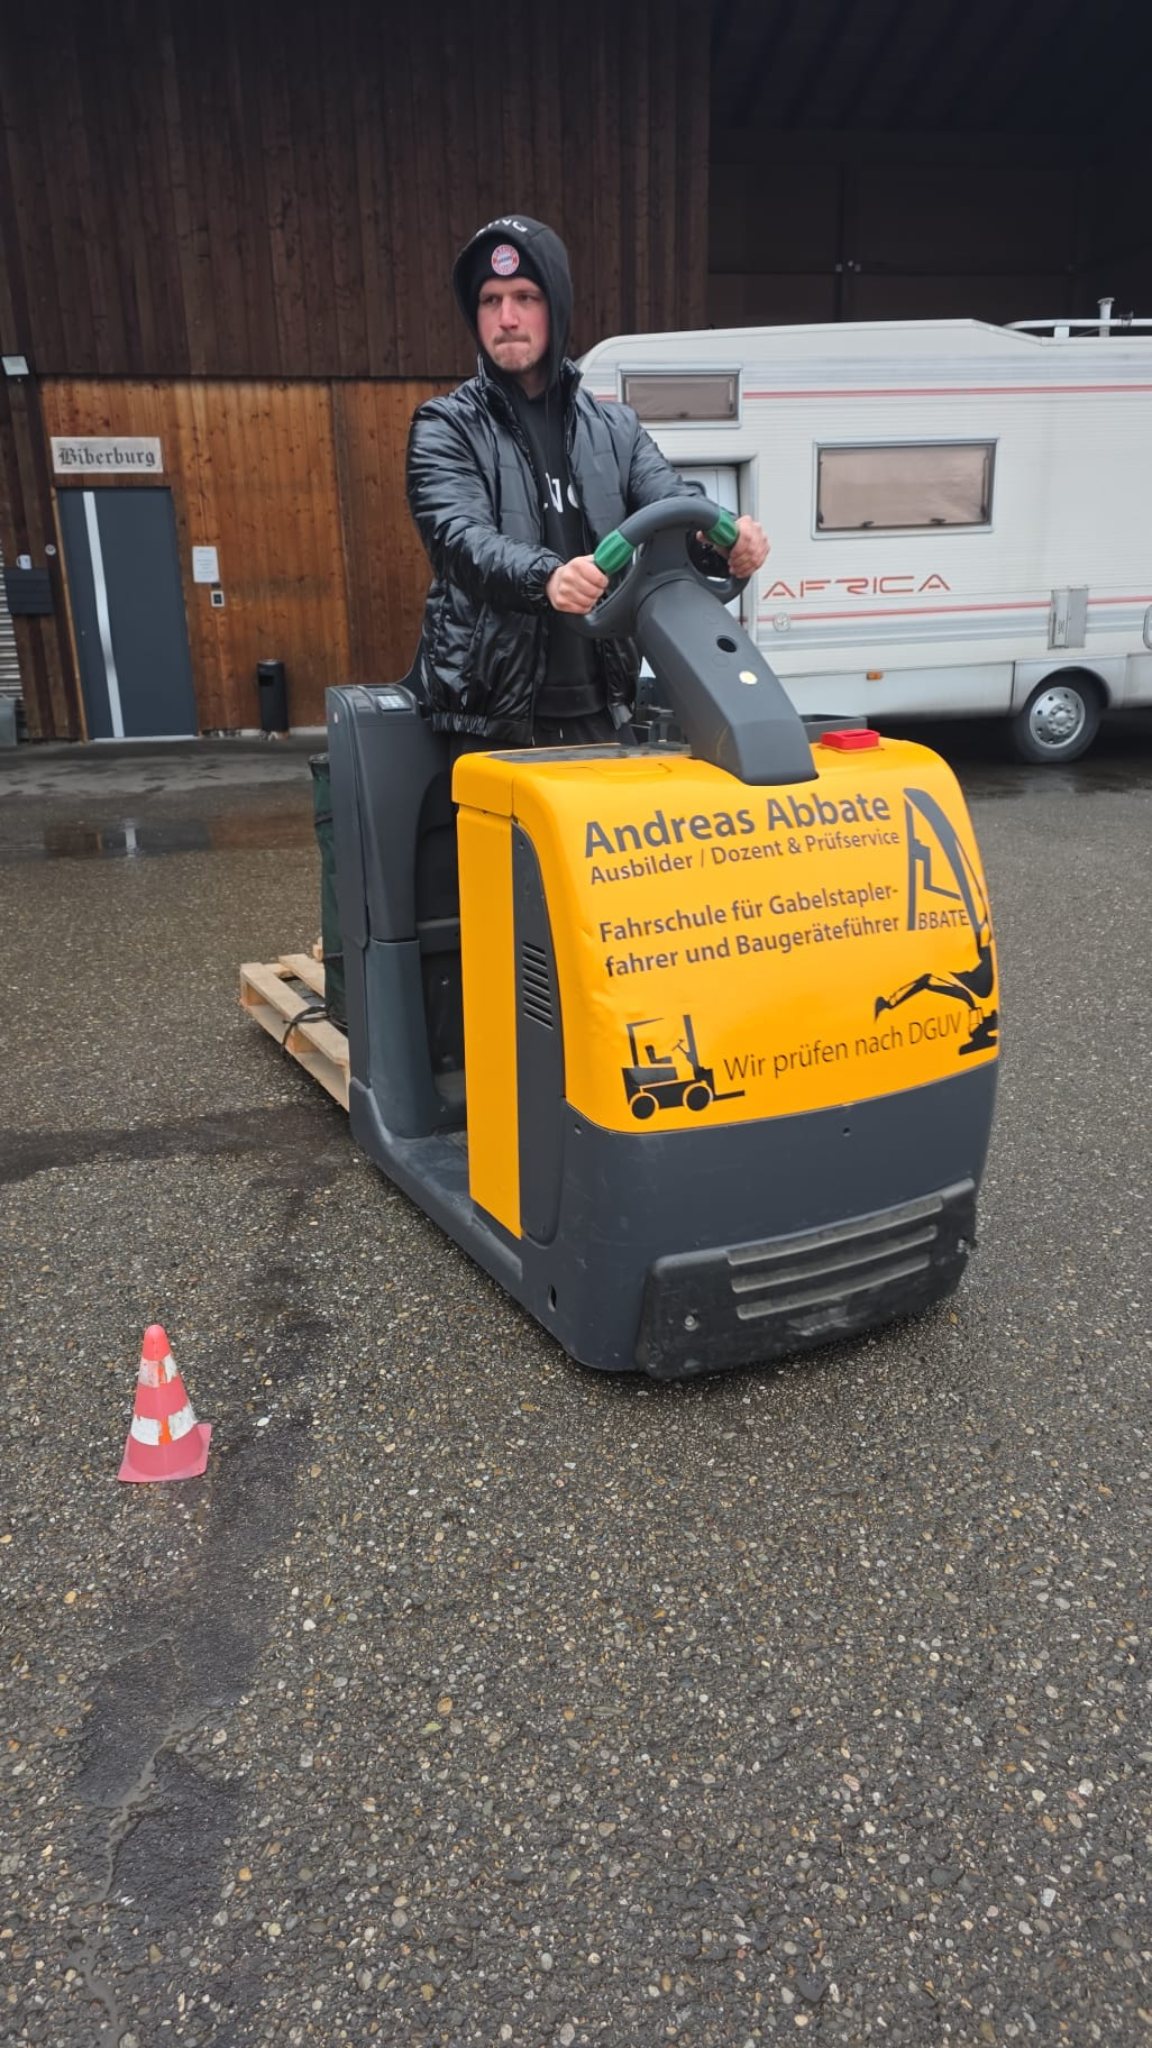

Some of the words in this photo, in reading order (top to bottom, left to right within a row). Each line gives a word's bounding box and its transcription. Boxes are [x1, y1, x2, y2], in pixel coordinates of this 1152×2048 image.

[58, 447, 156, 467] Biberburg
[763, 573, 951, 600] AFRICA
[584, 809, 756, 858] Andreas
[766, 793, 891, 831] Abbate
[591, 853, 693, 885] Ausbilder
[710, 840, 783, 865] Dozent
[787, 836, 802, 854] &
[804, 828, 901, 852] Prüfservice
[599, 904, 727, 943] Fahrschule
[731, 899, 763, 921] für
[768, 882, 899, 915] Gabelstapler-
[605, 951, 678, 978] fahrer
[685, 936, 731, 964] und
[735, 916, 899, 956] Baugeräteführer
[723, 1053, 766, 1081] Wir
[773, 1040, 848, 1079] prüfen
[854, 1025, 903, 1057] nach
[908, 1011, 962, 1045] DGUV
